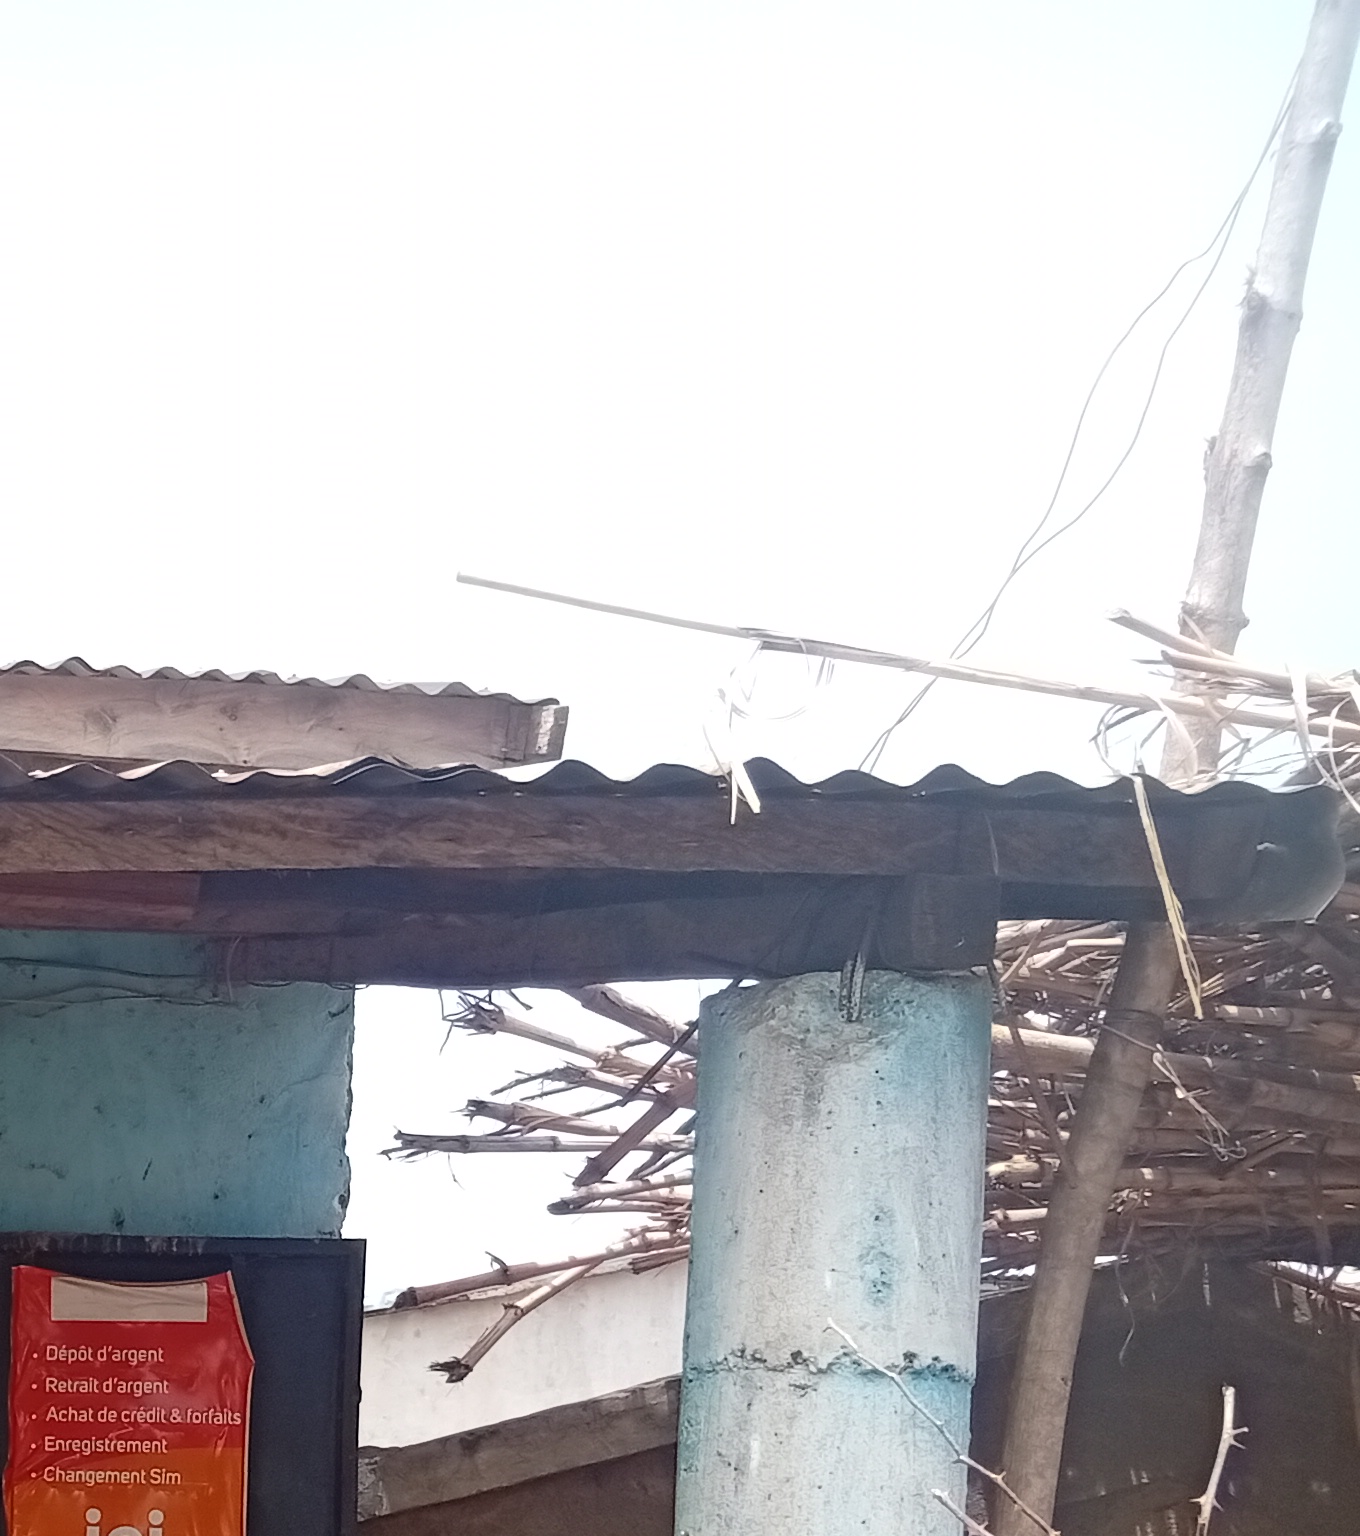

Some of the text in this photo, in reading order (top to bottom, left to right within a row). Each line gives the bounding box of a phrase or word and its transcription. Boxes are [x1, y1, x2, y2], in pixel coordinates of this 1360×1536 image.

[46, 1344, 94, 1364] Dépôt
[45, 1377, 100, 1394] Retrait
[45, 1406, 242, 1426] Achat de crédit & forfaits
[44, 1436, 168, 1456] Enregistrement
[43, 1466, 181, 1485] Changement Sim
